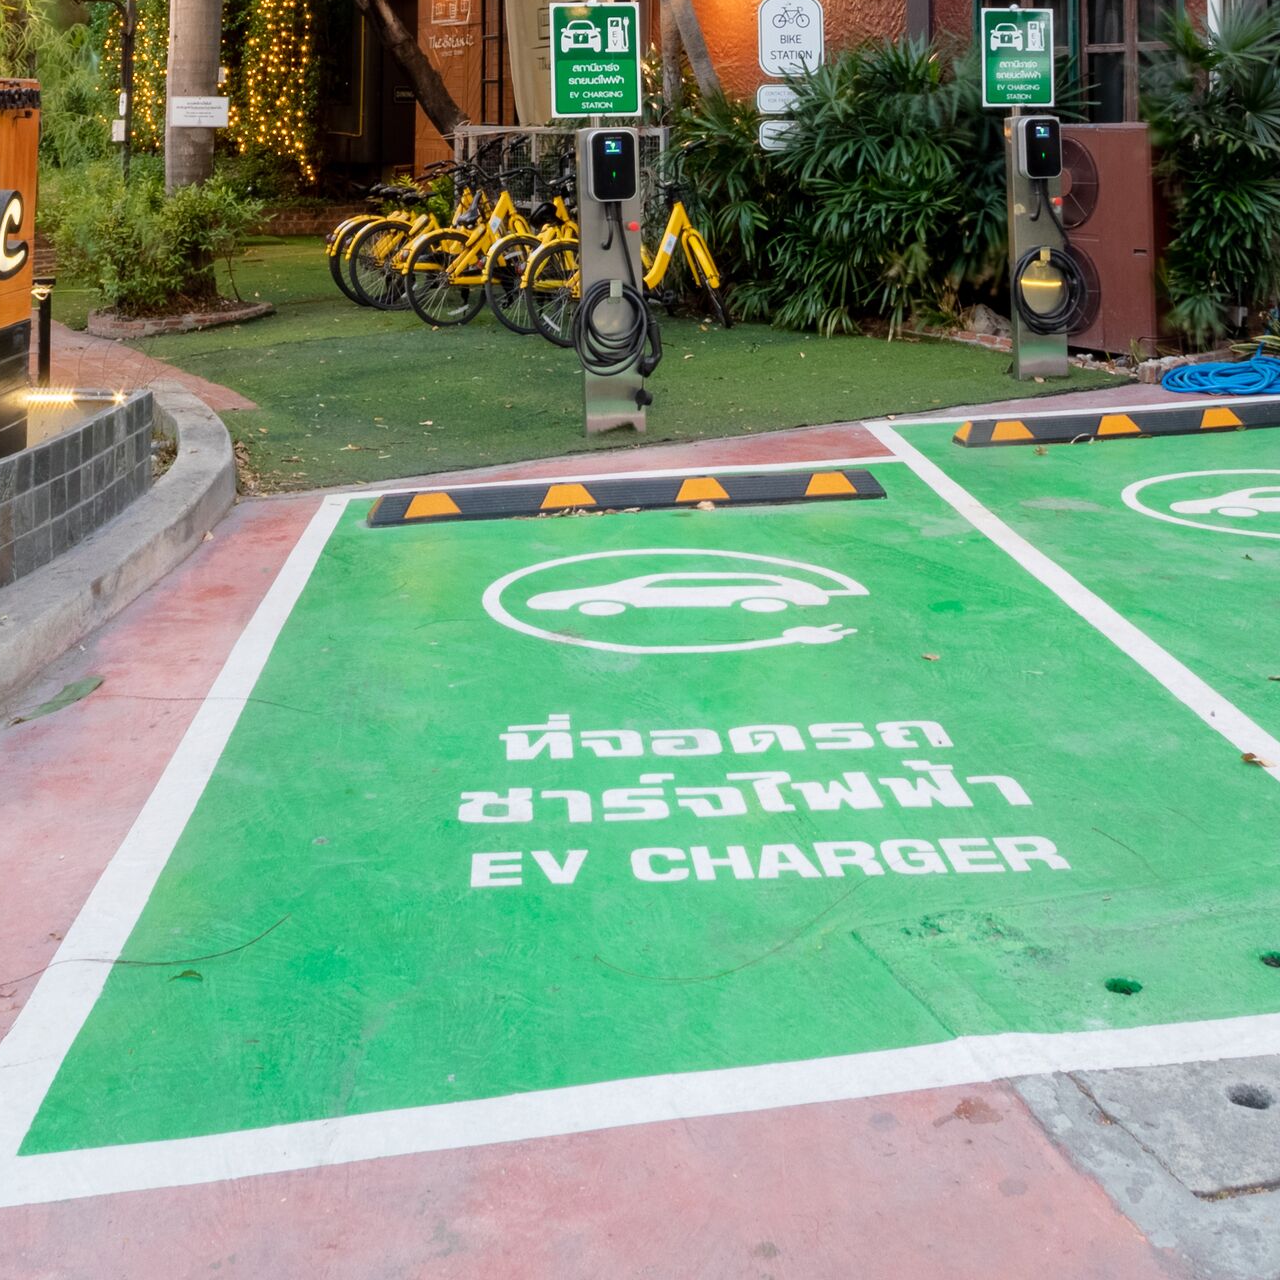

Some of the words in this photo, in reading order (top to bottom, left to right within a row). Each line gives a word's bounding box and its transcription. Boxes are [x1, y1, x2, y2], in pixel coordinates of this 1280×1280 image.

[780, 34, 802, 44] BIKE
[770, 50, 813, 60] STATION
[1007, 83, 1040, 91] CHARGING
[569, 91, 580, 99] EV
[582, 90, 623, 99] CHARGING
[581, 101, 613, 110] STATION
[498, 714, 955, 762] ที่จอดรถ
[457, 760, 1034, 824] ชาร์จไฟฟ้า
[468, 849, 589, 888] EV
[629, 835, 1072, 883] CHARGER
